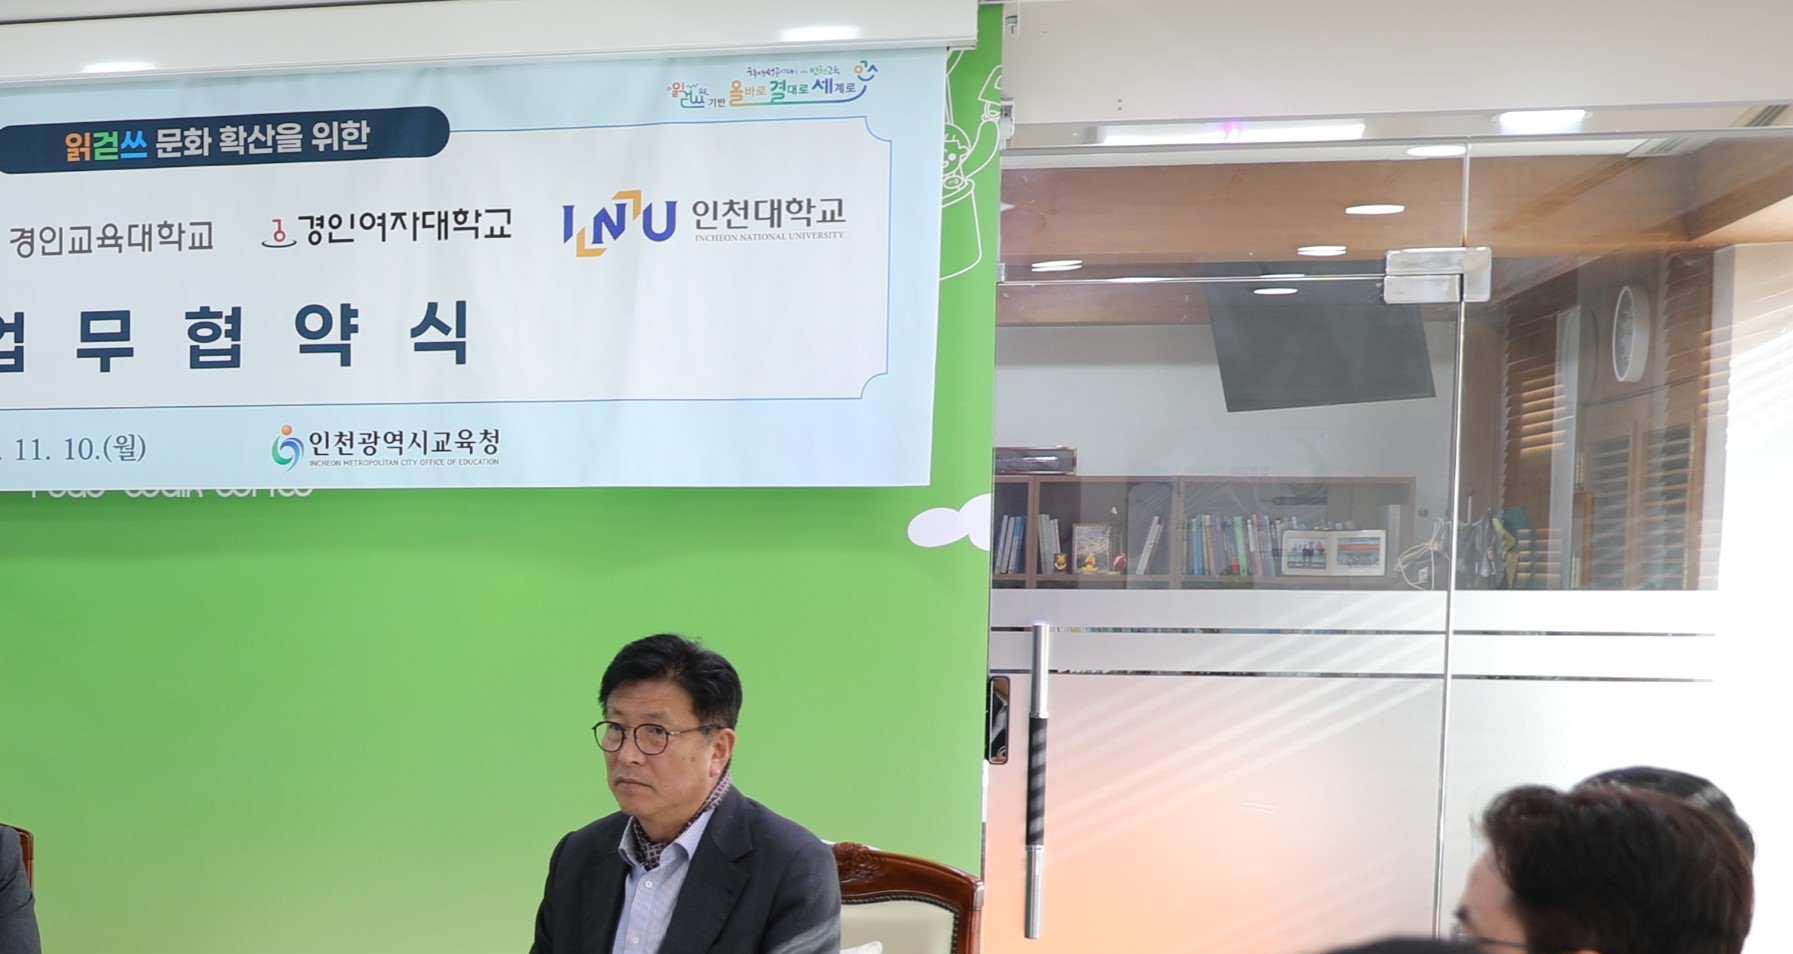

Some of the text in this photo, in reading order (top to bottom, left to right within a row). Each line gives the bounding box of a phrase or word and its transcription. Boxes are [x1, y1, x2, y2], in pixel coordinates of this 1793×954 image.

[729, 80, 767, 106] 올바로
[769, 79, 809, 103] 결대로
[812, 78, 856, 94] 세계로
[65, 119, 370, 162] 읽걷쓰 문화 확산을 위한
[298, 207, 513, 246] 경인여자대학교
[562, 195, 678, 250] INU
[692, 197, 846, 230] 인천대학교
[9, 220, 214, 259] 경인교육대학교
[695, 231, 845, 242] INCHEON NATIONAL UNIVERSITY
[16, 437, 51, 462] 11.
[64, 433, 147, 464] 10.(월)
[309, 429, 499, 456] 인천광역시교육청
[343, 459, 398, 467] METROPOLITAN
